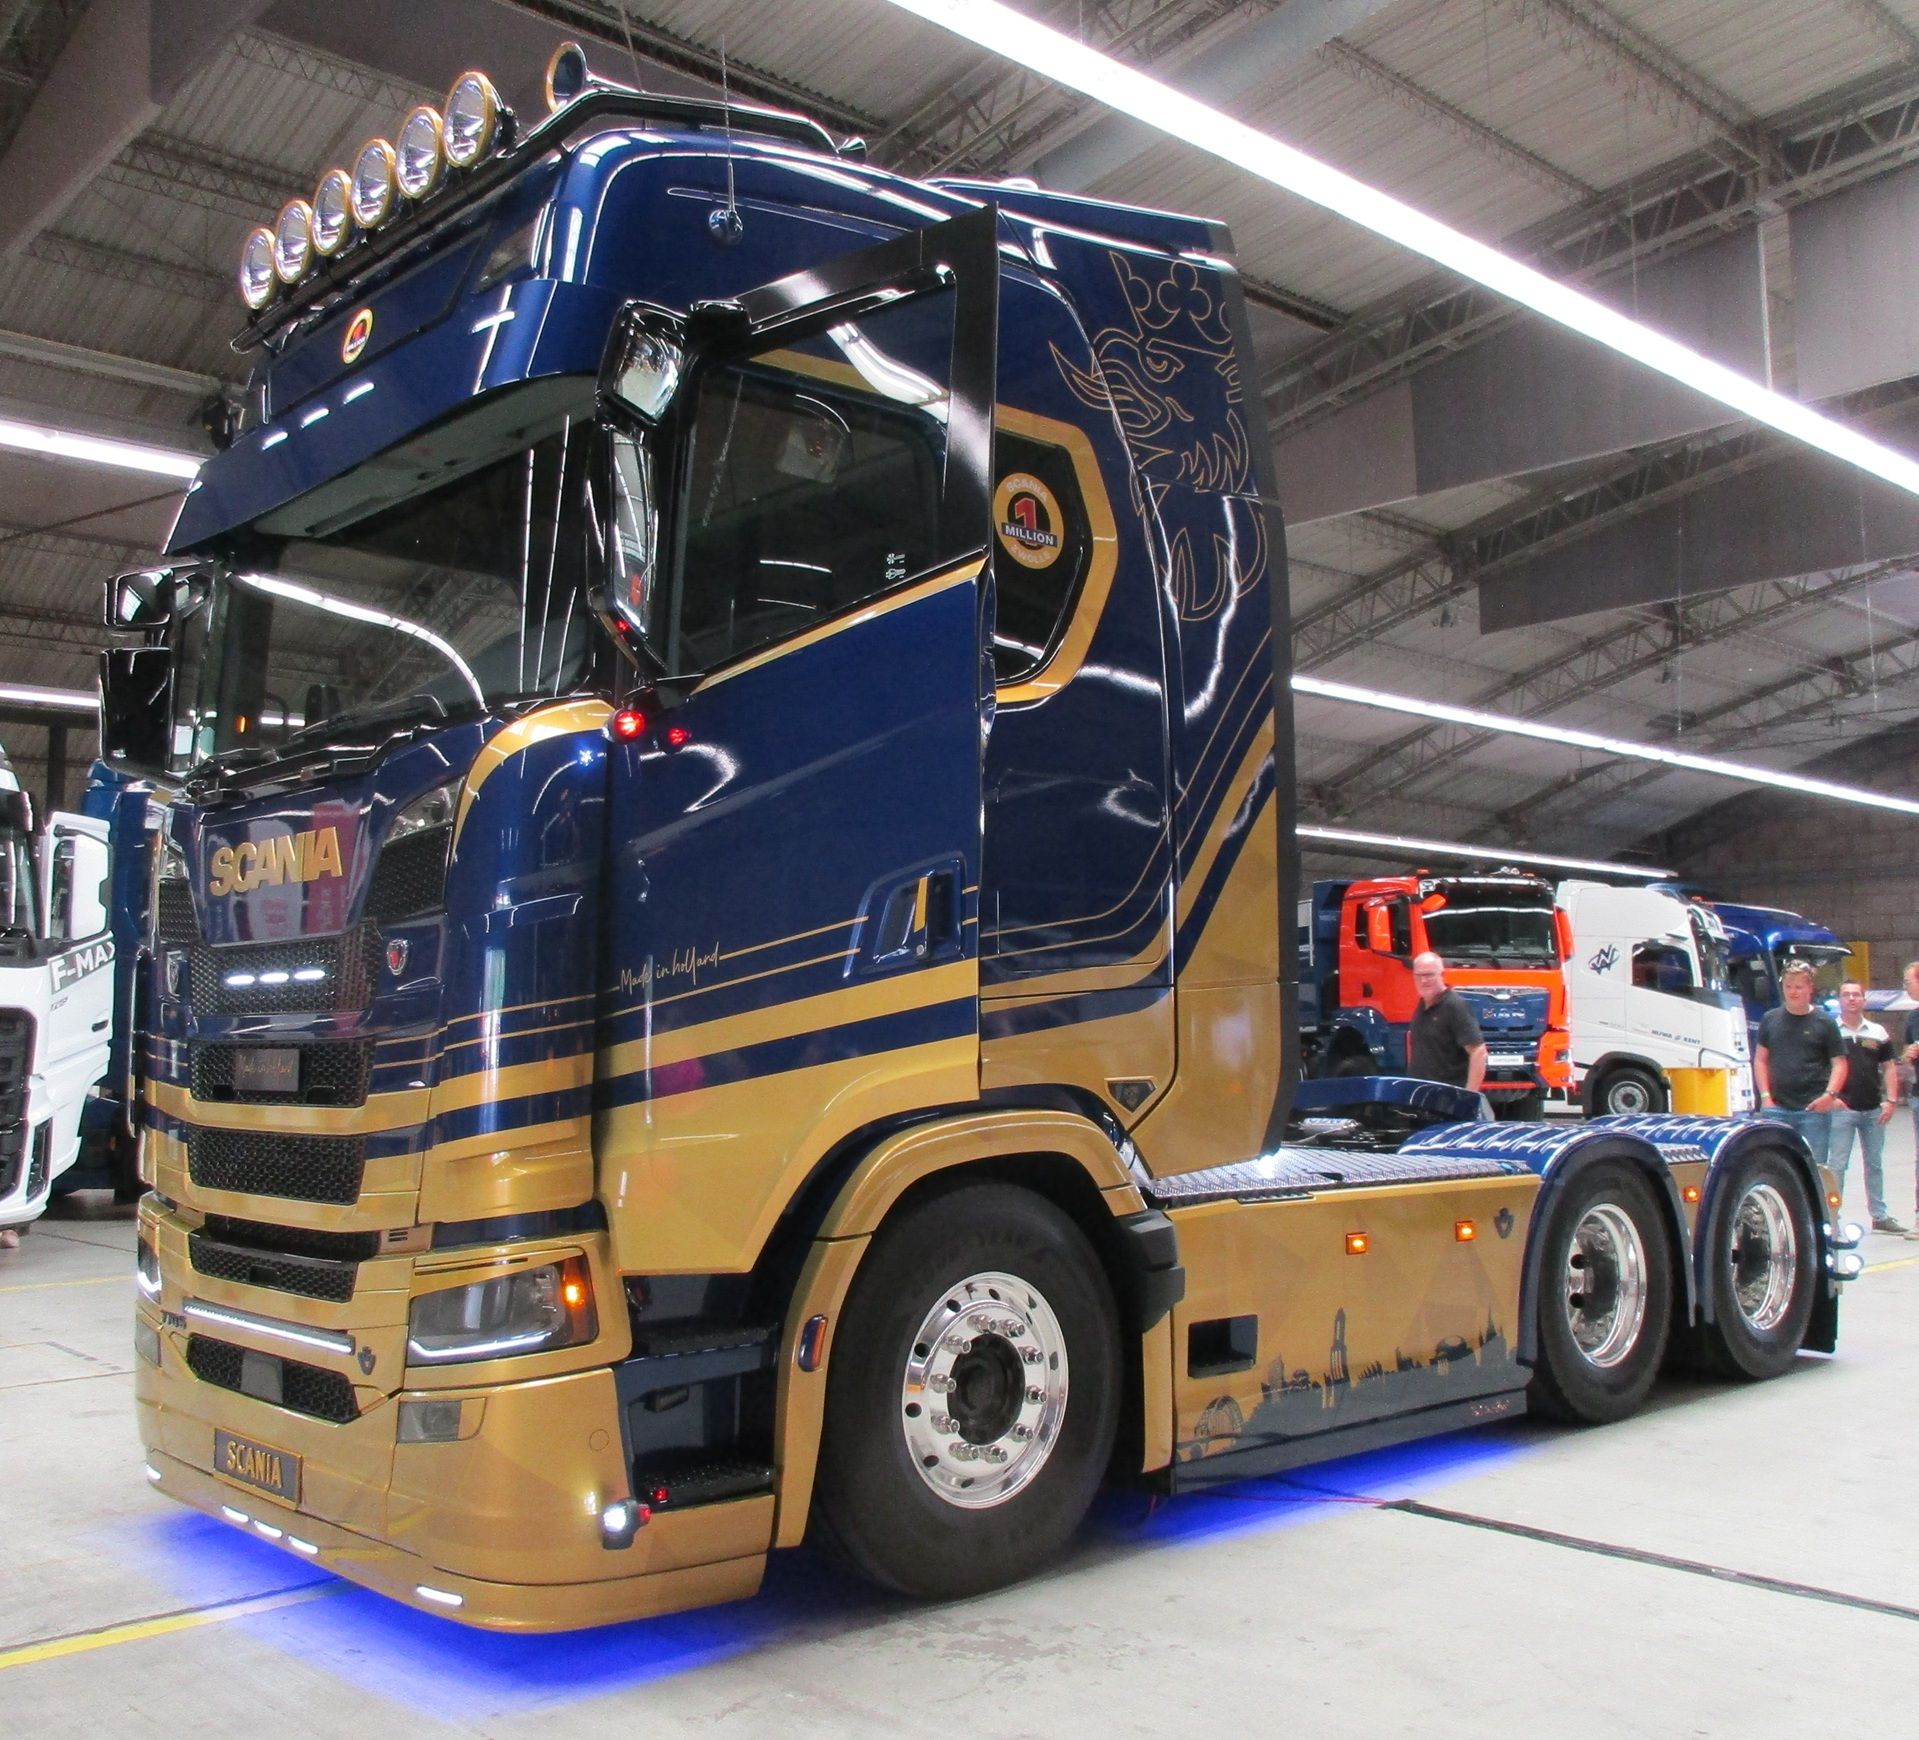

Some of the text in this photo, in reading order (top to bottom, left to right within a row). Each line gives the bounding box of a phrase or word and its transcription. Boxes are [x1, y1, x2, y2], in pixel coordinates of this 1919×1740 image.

[1004, 525, 1054, 545] MILLION
[1015, 497, 1037, 546] 1
[209, 826, 342, 896] SCANIA
[621, 962, 652, 995] Made
[656, 963, 669, 979] in
[227, 1440, 282, 1488] SCANIA
